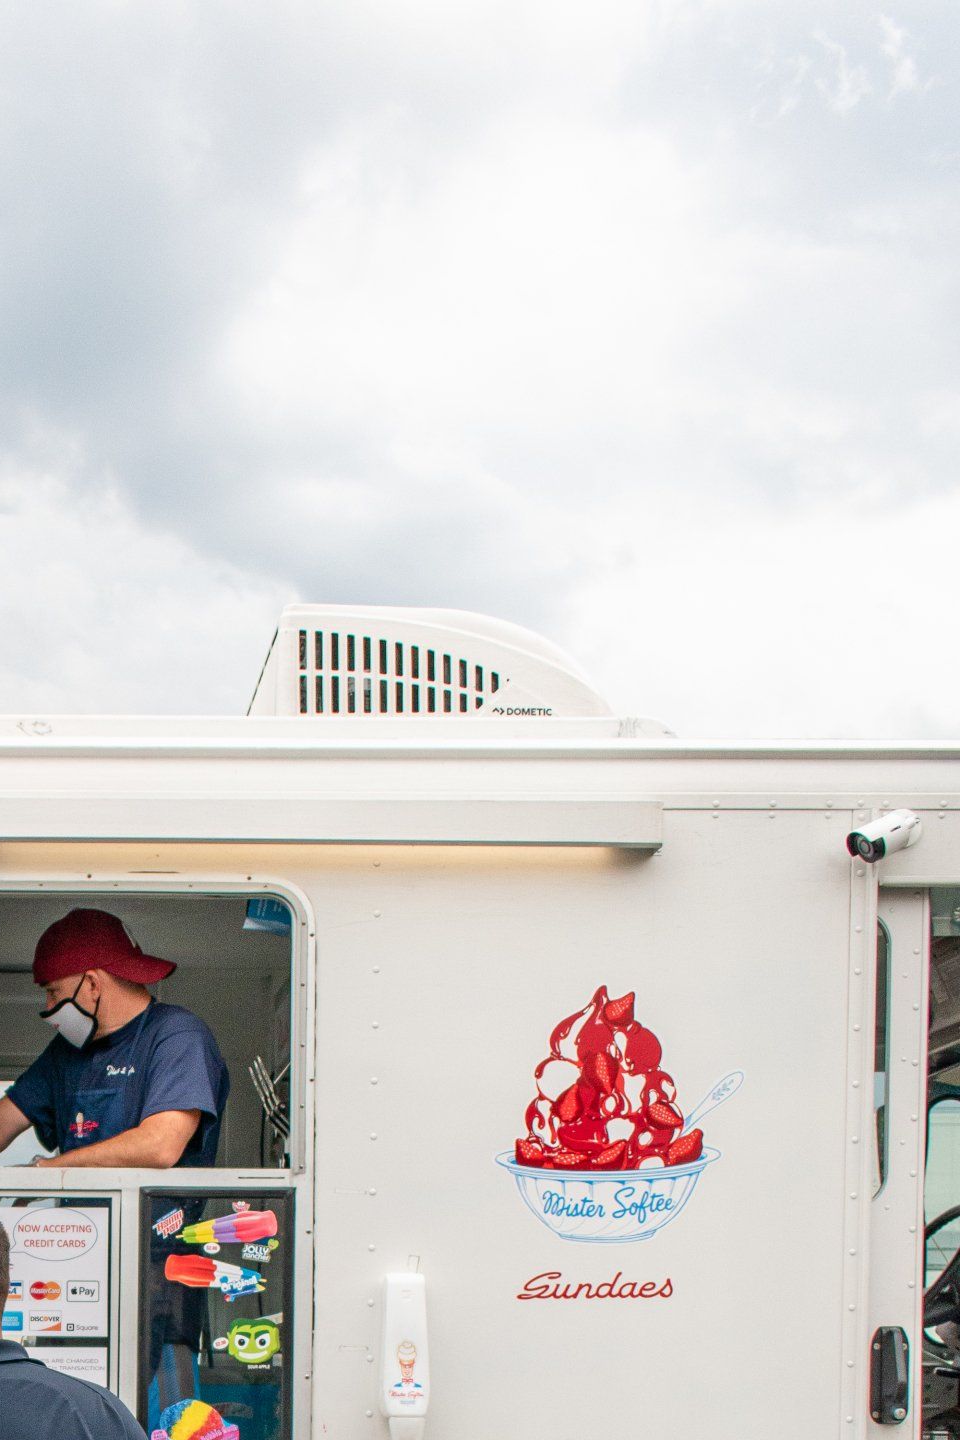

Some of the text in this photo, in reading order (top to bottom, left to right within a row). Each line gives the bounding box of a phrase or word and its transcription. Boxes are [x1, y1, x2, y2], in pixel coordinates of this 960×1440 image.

[506, 708, 552, 716] DOMETIC
[542, 1186, 674, 1223] Mister Softee
[17, 1225, 92, 1233] NOW ACCEPTING
[24, 1240, 86, 1248] CREDIT CARDS
[243, 1243, 270, 1254] JOLLY
[516, 1271, 673, 1300] Sundaes
[79, 1287, 95, 1297] Pay
